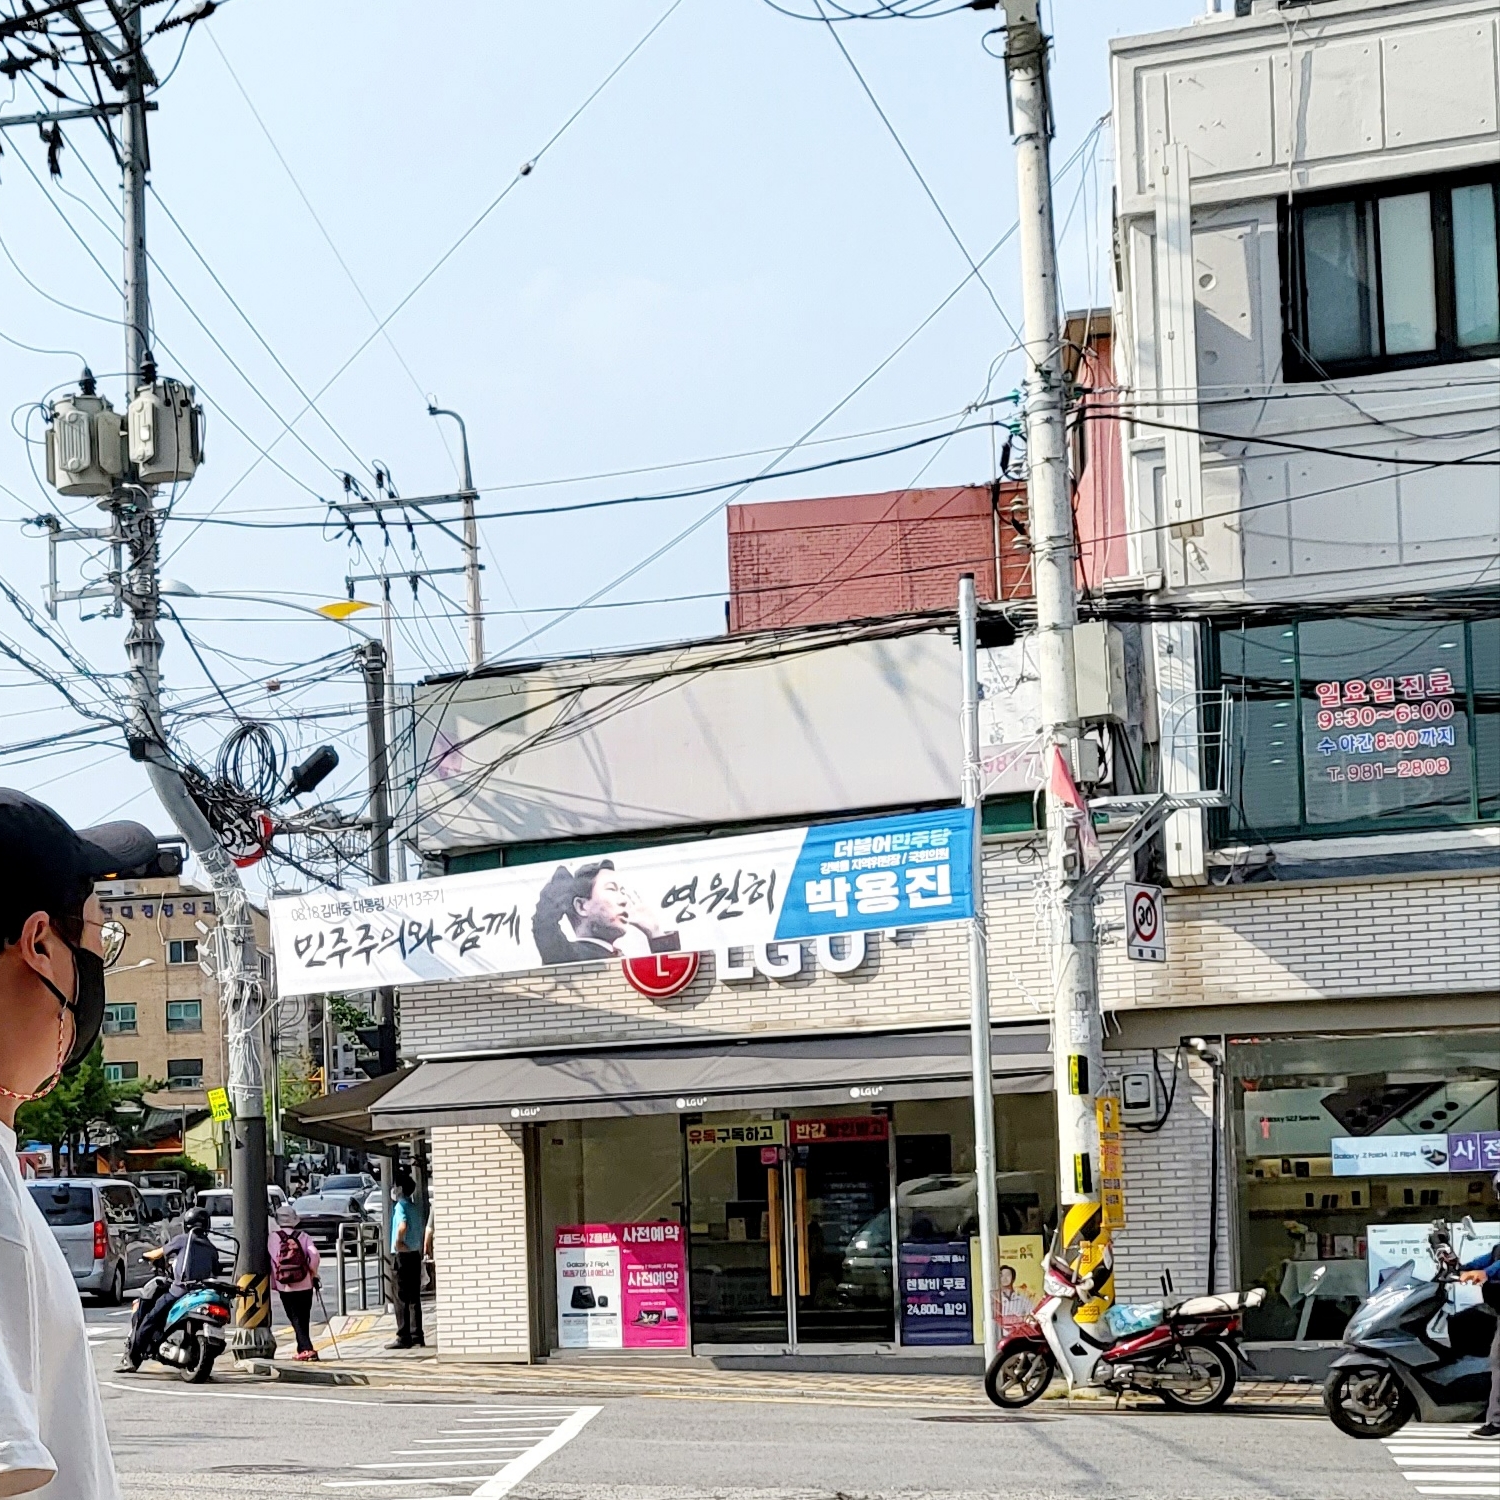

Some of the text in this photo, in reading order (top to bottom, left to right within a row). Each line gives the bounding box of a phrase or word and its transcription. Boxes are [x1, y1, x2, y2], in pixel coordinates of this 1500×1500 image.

[1316, 672, 1456, 708] 일요일 진료
[1317, 699, 1455, 731] 9:30~6:00
[1318, 736, 1337, 757] 수
[834, 828, 953, 859] 더불어민주당
[908, 846, 950, 863] 국회의원
[660, 867, 777, 924] 영원히
[805, 864, 953, 919] 박용진
[320, 901, 352, 918] 김대중
[353, 896, 385, 915] 대통령
[1137, 905, 1153, 927] 30
[294, 904, 521, 969] 민주주의와 함께
[622, 1225, 680, 1243] 사전예약
[627, 1271, 679, 1287] 사전예약
[906, 1277, 967, 1291] 렌탈비 무료
[944, 1302, 967, 1316] 할인
